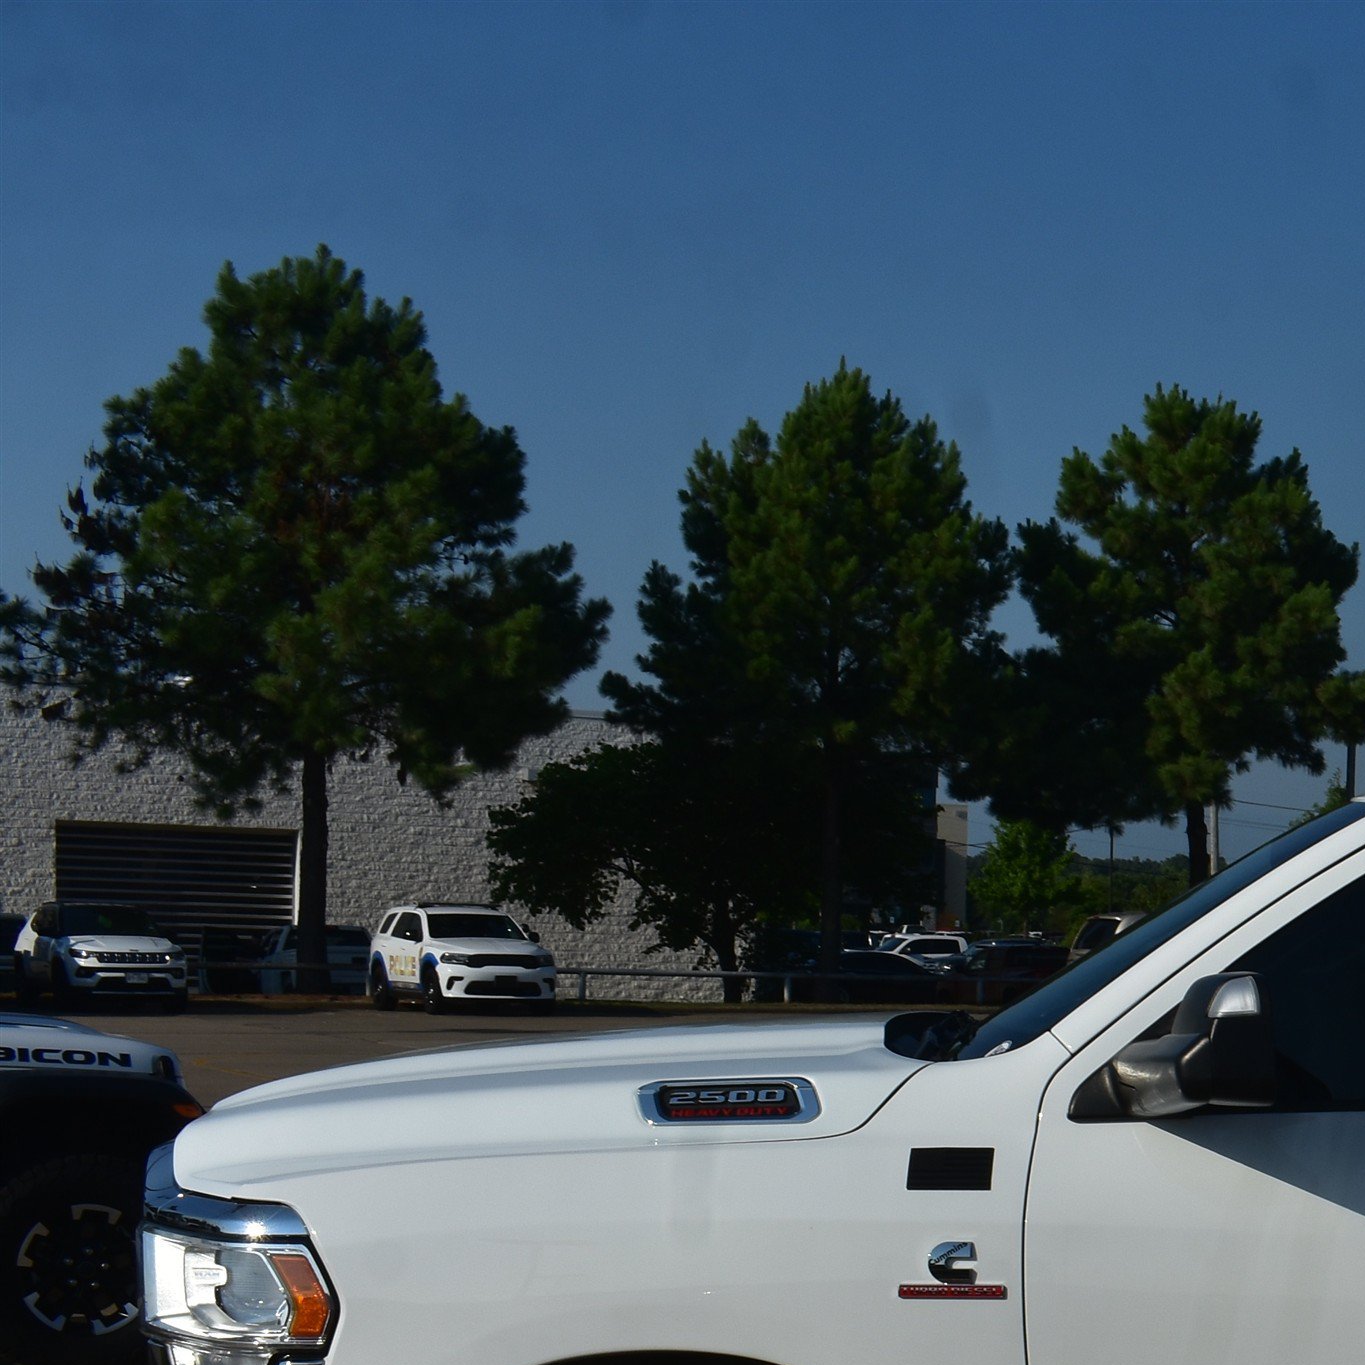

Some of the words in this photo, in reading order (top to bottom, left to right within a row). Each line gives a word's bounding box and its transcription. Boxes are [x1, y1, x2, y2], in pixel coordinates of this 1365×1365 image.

[668, 1089, 785, 1105] 2500
[670, 1108, 733, 1118] HEAVY
[735, 1107, 789, 1117] DUTY
[928, 1242, 969, 1265] Cummins
